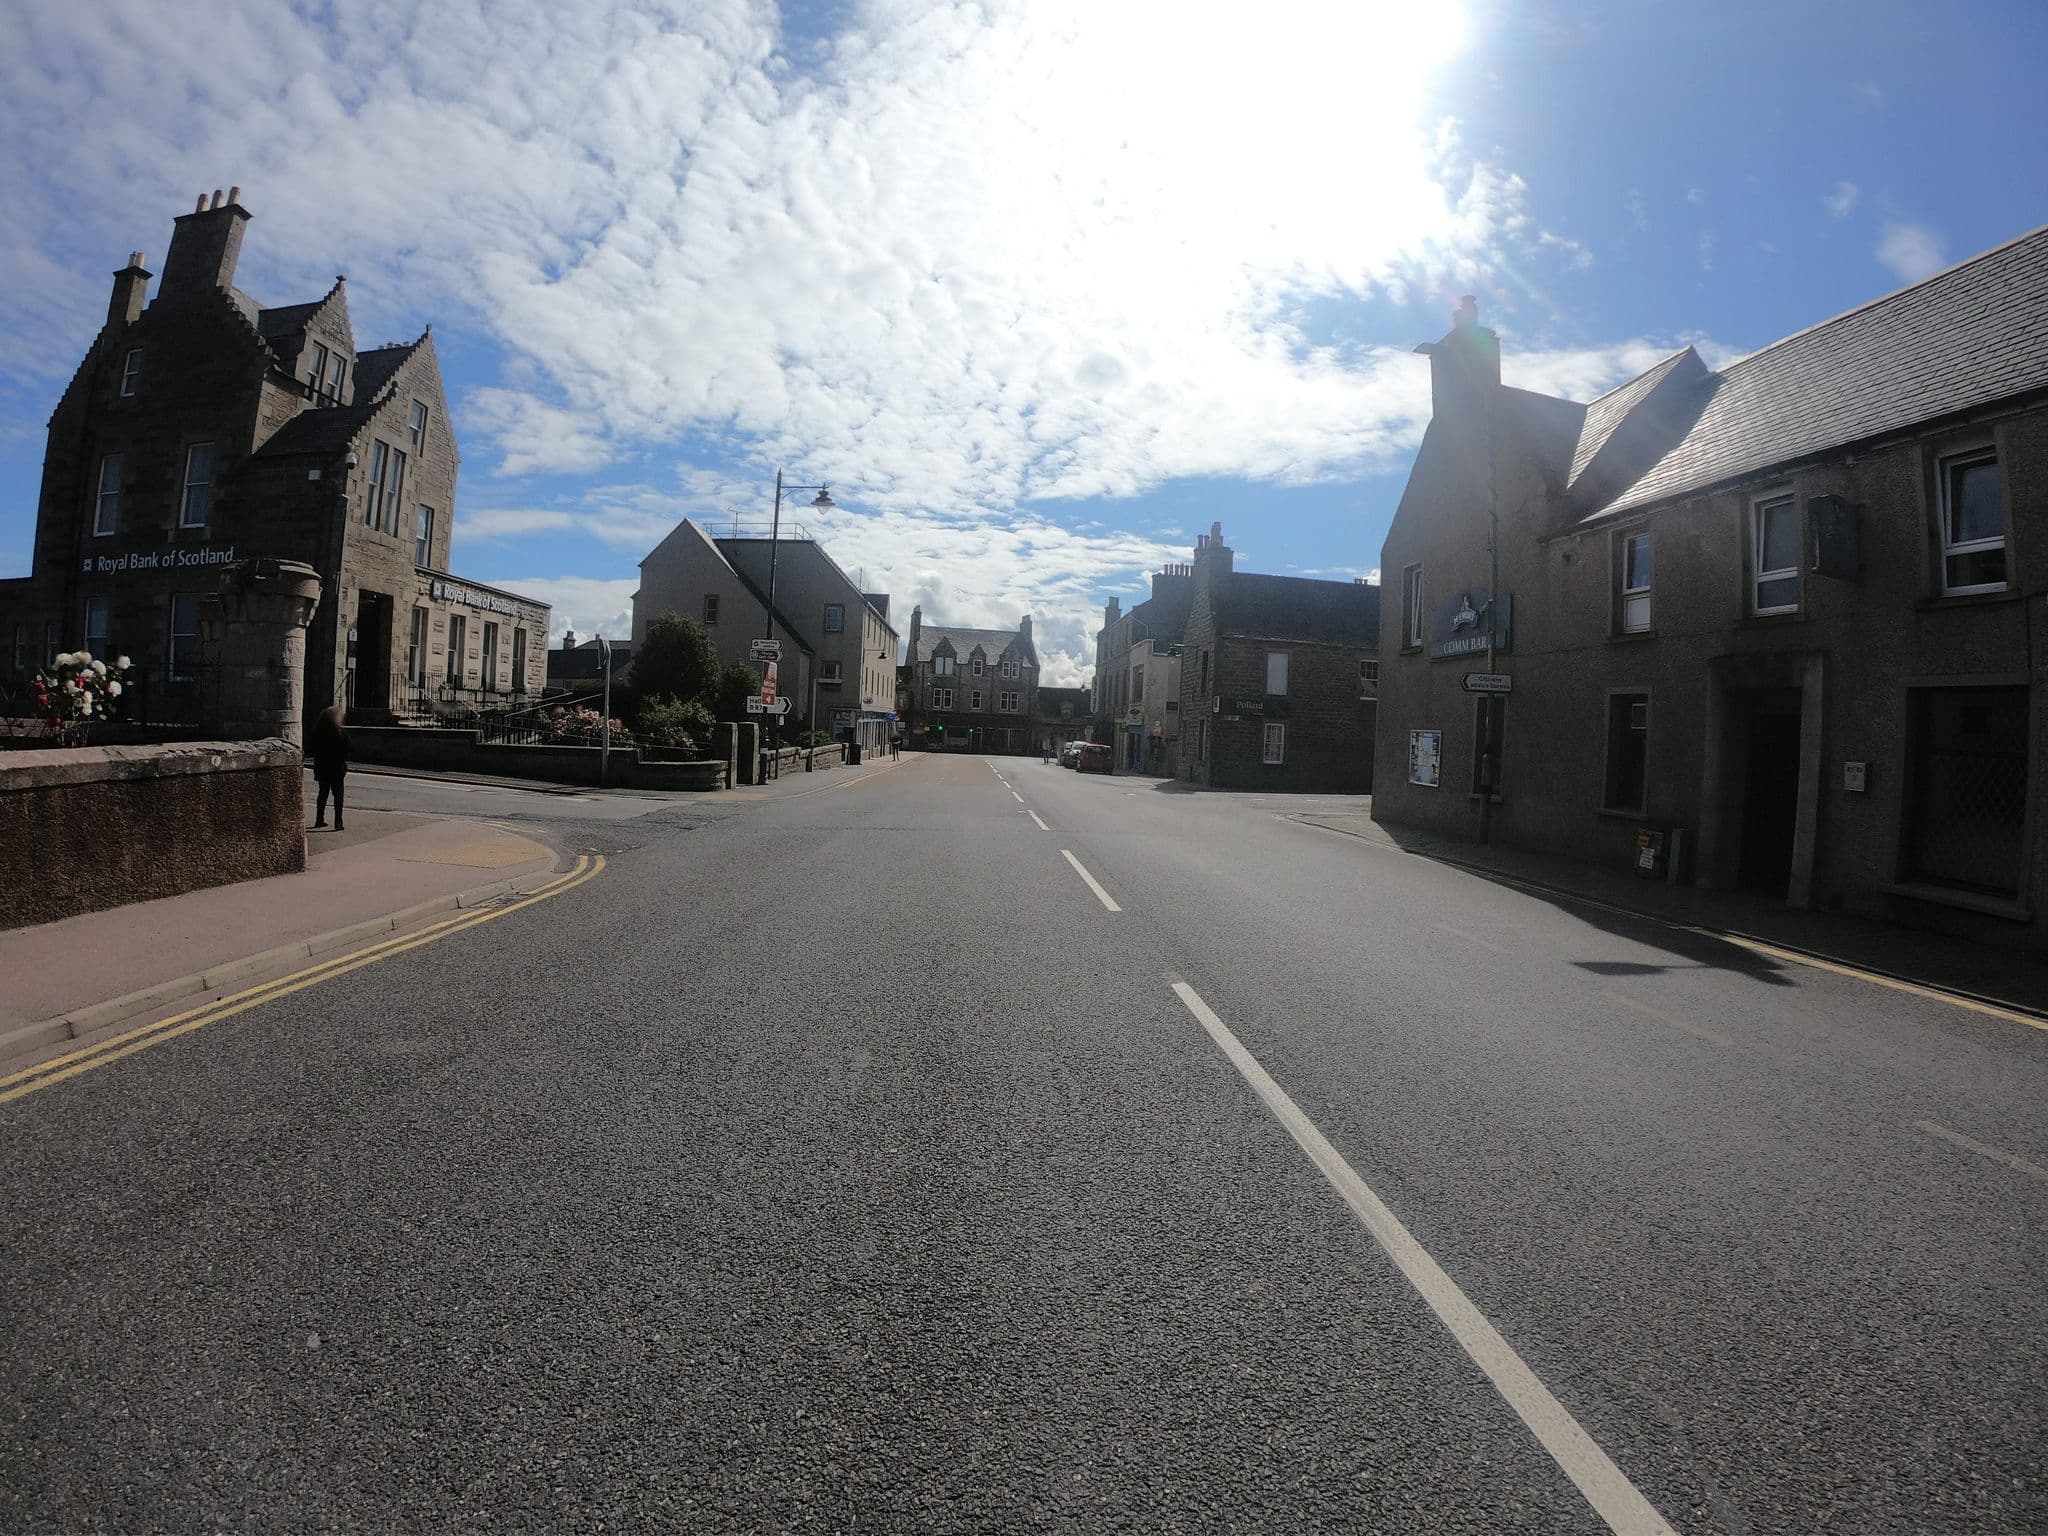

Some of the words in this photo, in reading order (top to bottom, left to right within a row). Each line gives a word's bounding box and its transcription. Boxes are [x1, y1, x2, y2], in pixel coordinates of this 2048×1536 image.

[98, 554, 128, 575] Royal
[130, 552, 159, 569] Bank
[162, 550, 176, 567] of
[178, 546, 234, 566] Scotland
[444, 583, 465, 605] Royal
[466, 590, 482, 606] Bank
[483, 596, 491, 609] of
[491, 597, 518, 614] Scotland
[1470, 636, 1487, 650] BAR
[1236, 700, 1264, 710] Pollard
